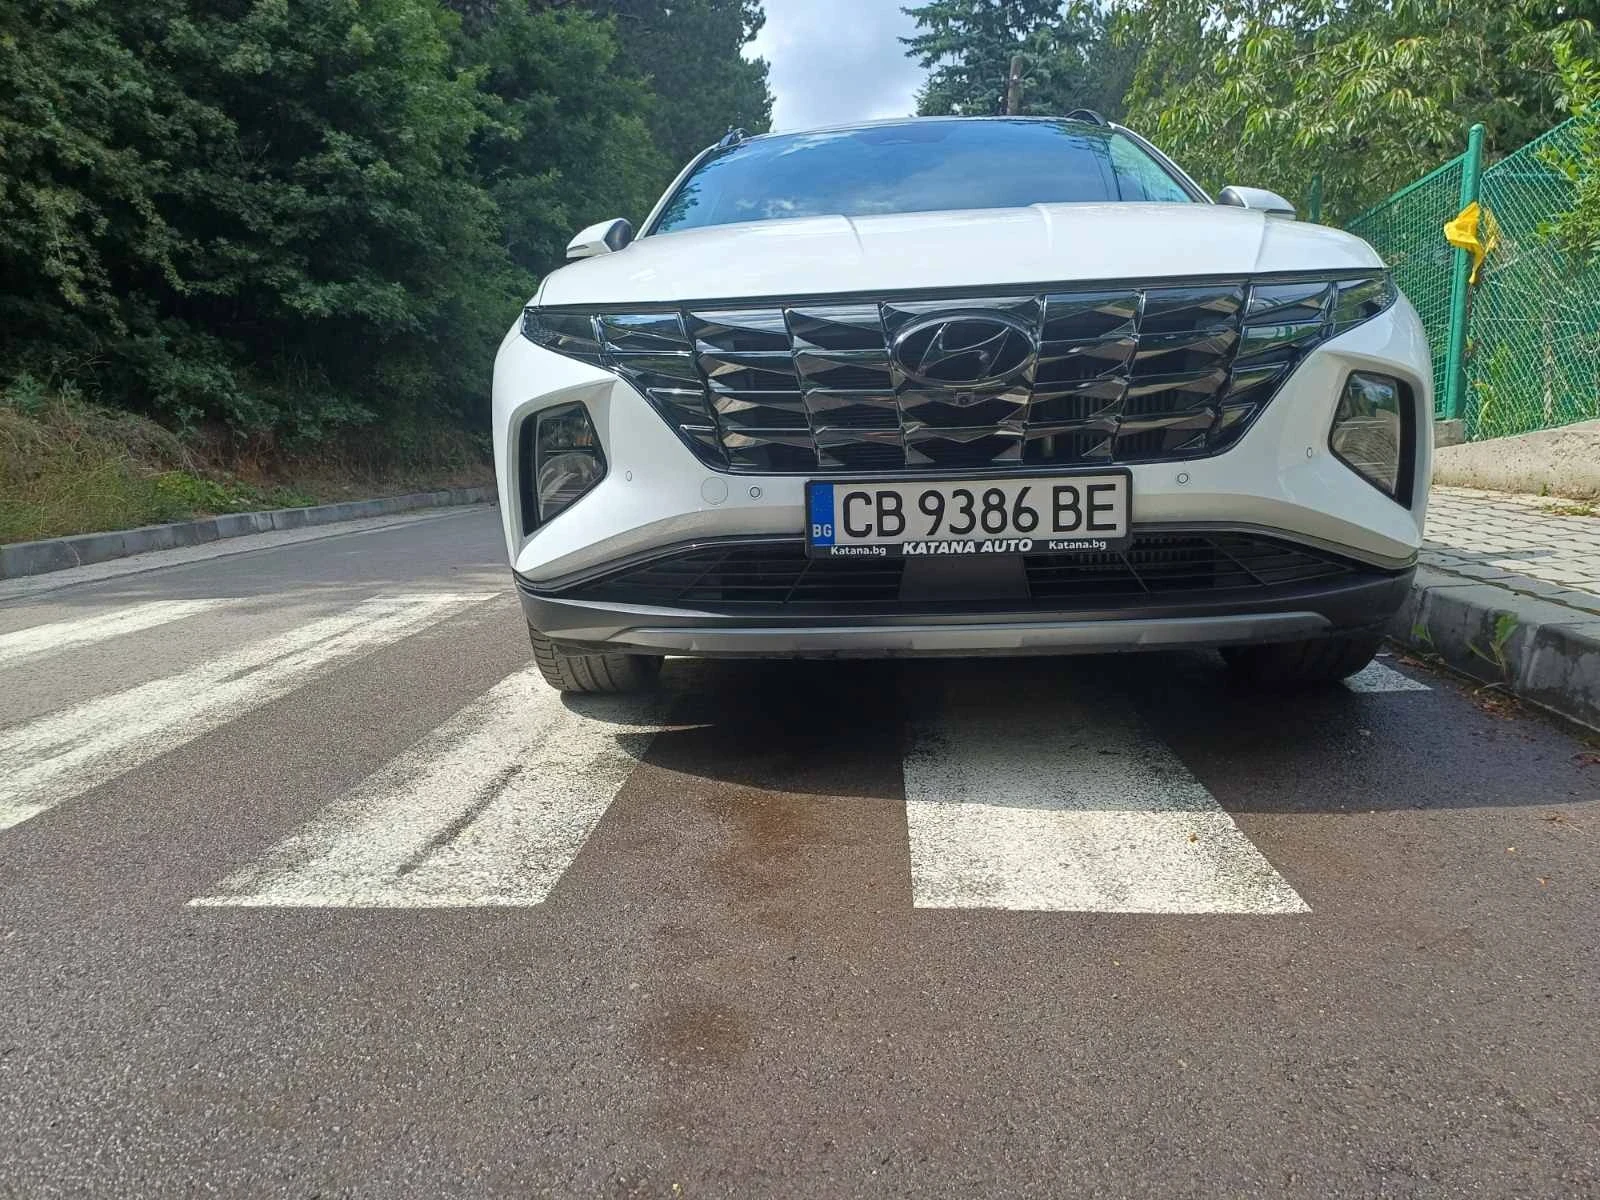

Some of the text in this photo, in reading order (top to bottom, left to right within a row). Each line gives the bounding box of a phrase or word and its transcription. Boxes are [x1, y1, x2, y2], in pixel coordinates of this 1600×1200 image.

[842, 483, 1117, 538] CB 9386 BE
[811, 523, 833, 537] BG
[830, 545, 887, 556] Katana.bg
[902, 538, 1033, 555] KATANA AUTO
[1049, 539, 1107, 550] Katana.bg
